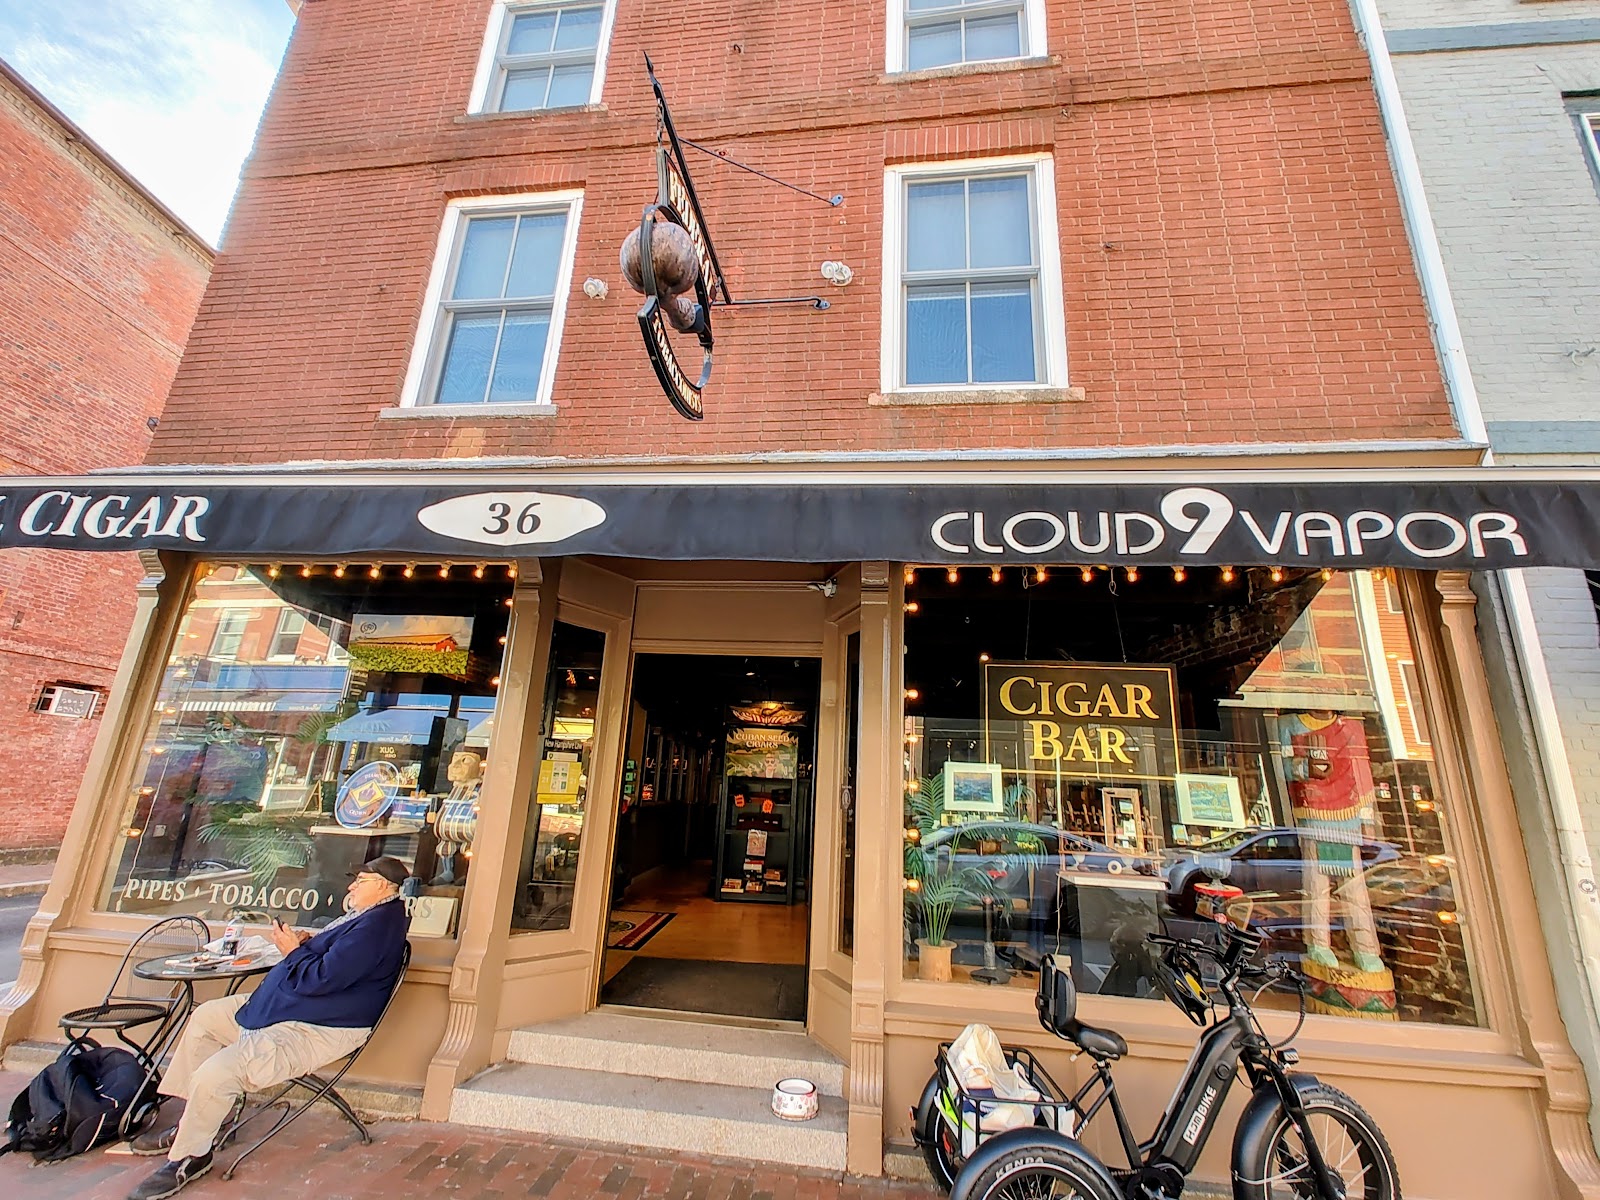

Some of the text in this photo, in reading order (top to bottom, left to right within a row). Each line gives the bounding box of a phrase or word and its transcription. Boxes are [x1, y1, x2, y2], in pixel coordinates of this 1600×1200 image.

[19, 490, 209, 542] CIGAR
[482, 501, 541, 535] 36
[930, 487, 1528, 558] CLOUD 9 VAPOR
[999, 676, 1159, 719] CIGAR
[735, 733, 766, 741] CUBAN
[746, 741, 779, 749] CIGARS
[1029, 720, 1133, 764] BAR
[124, 878, 187, 902] PIPES
[208, 882, 319, 911] TOBACCO
[1197, 1085, 1217, 1118] BIKE
[994, 1156, 1045, 1179] KENDA
